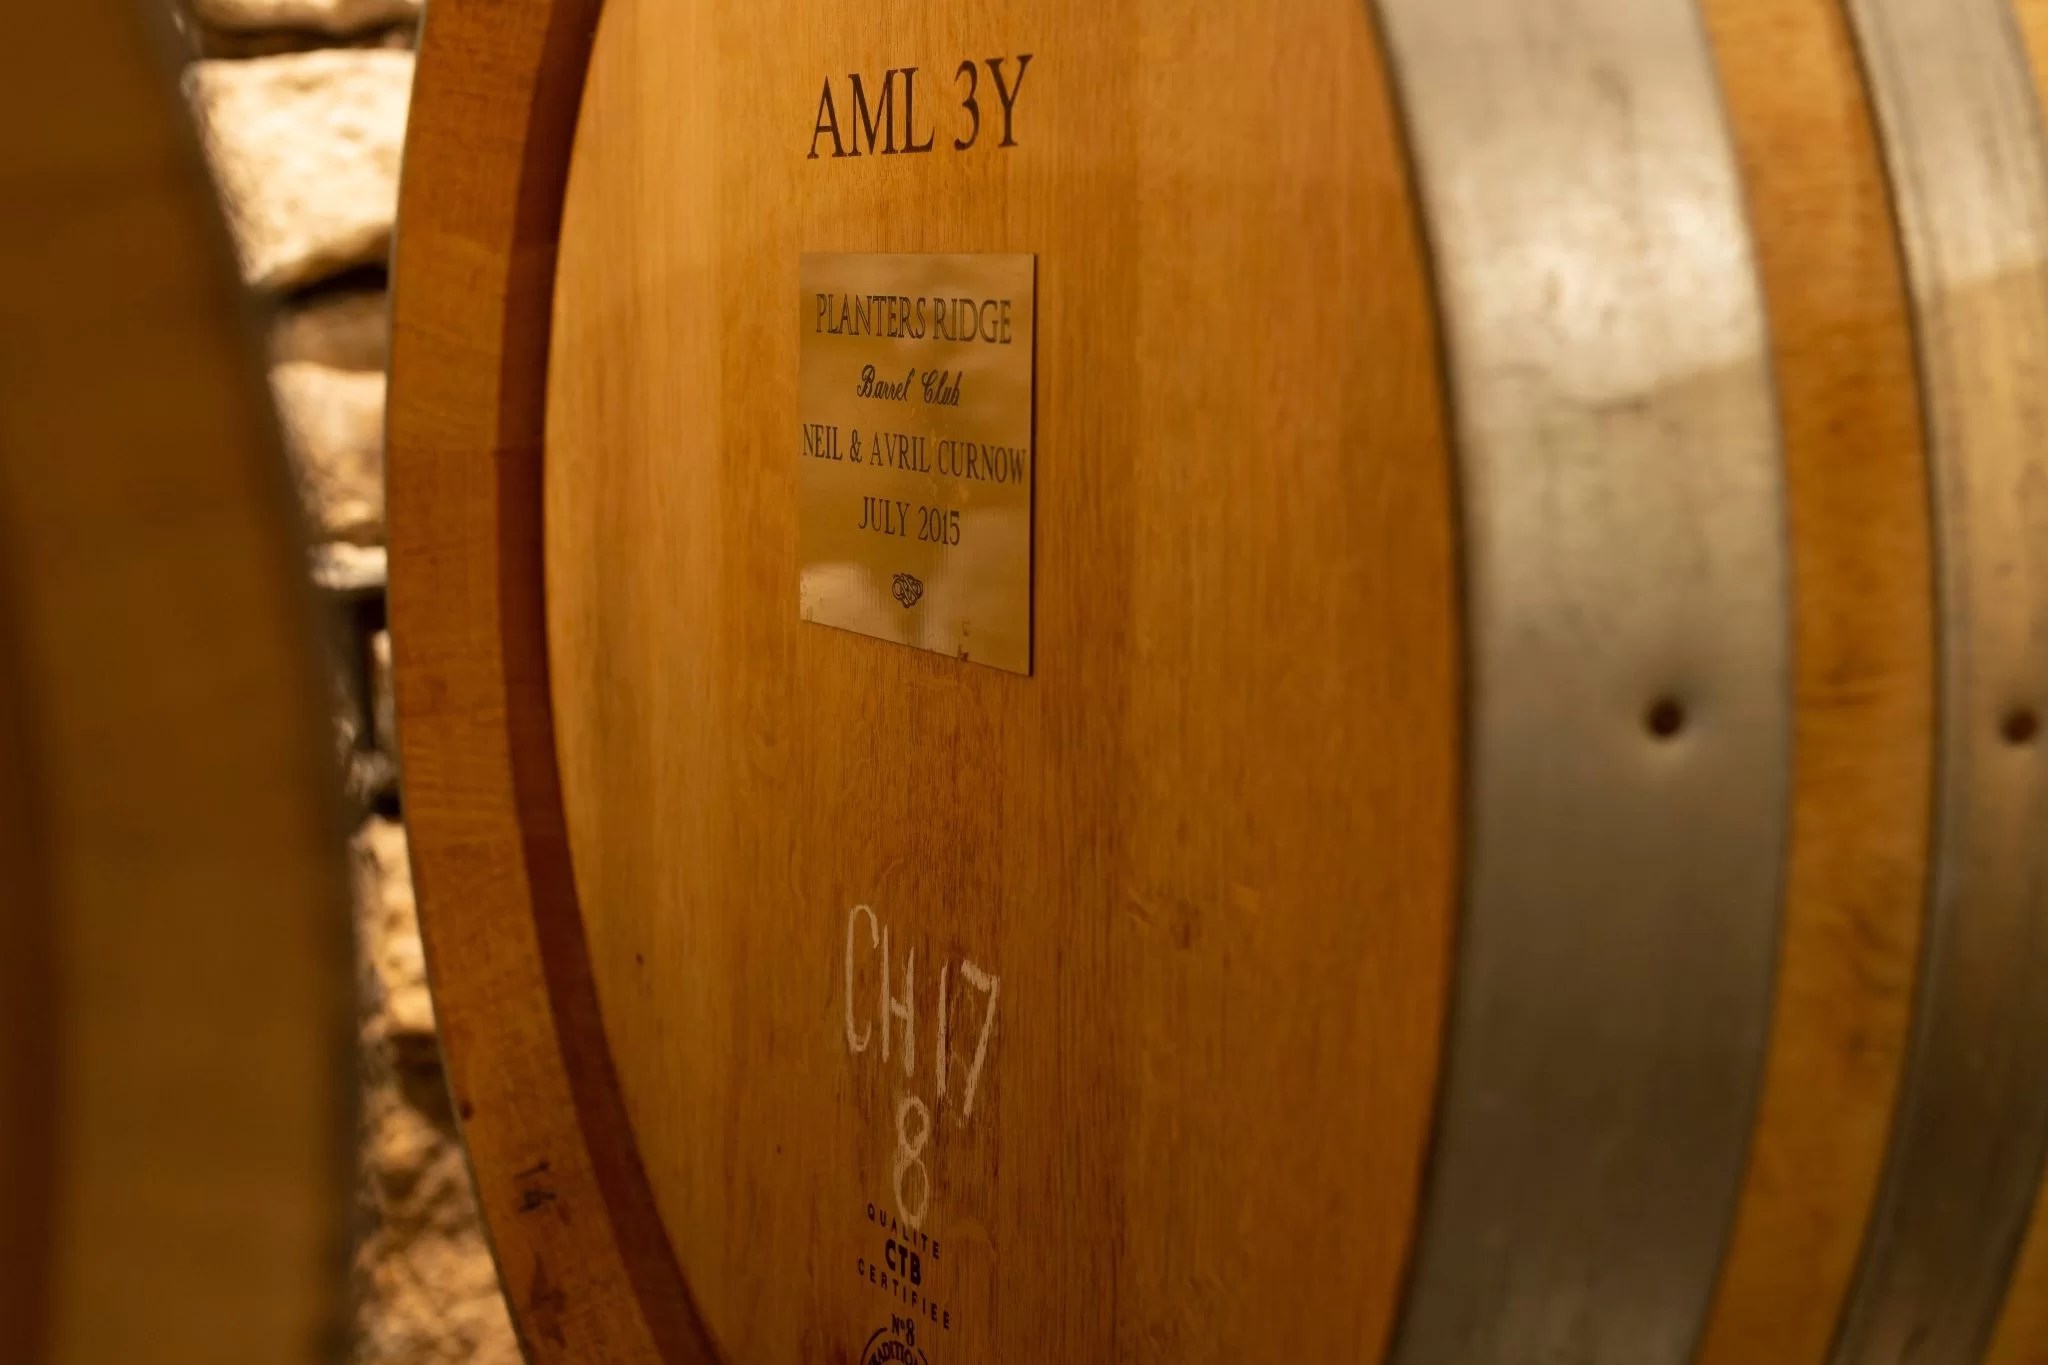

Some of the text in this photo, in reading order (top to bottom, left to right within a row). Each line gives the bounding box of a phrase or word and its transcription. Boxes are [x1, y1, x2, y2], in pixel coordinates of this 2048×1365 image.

[806, 53, 1033, 159] AML 3Y
[816, 293, 1012, 344] PLANTERS RIDGE
[857, 364, 962, 407] Barrel Club
[803, 424, 1027, 485] NEIL & AVRIL CURNOW
[858, 496, 960, 546] JULY 2015
[846, 904, 999, 1118] CH 17
[893, 1095, 930, 1230] 8
[867, 1202, 940, 1260] QUALITE
[885, 1238, 921, 1286] CTB
[857, 1257, 950, 1330] CERTIFIEE
